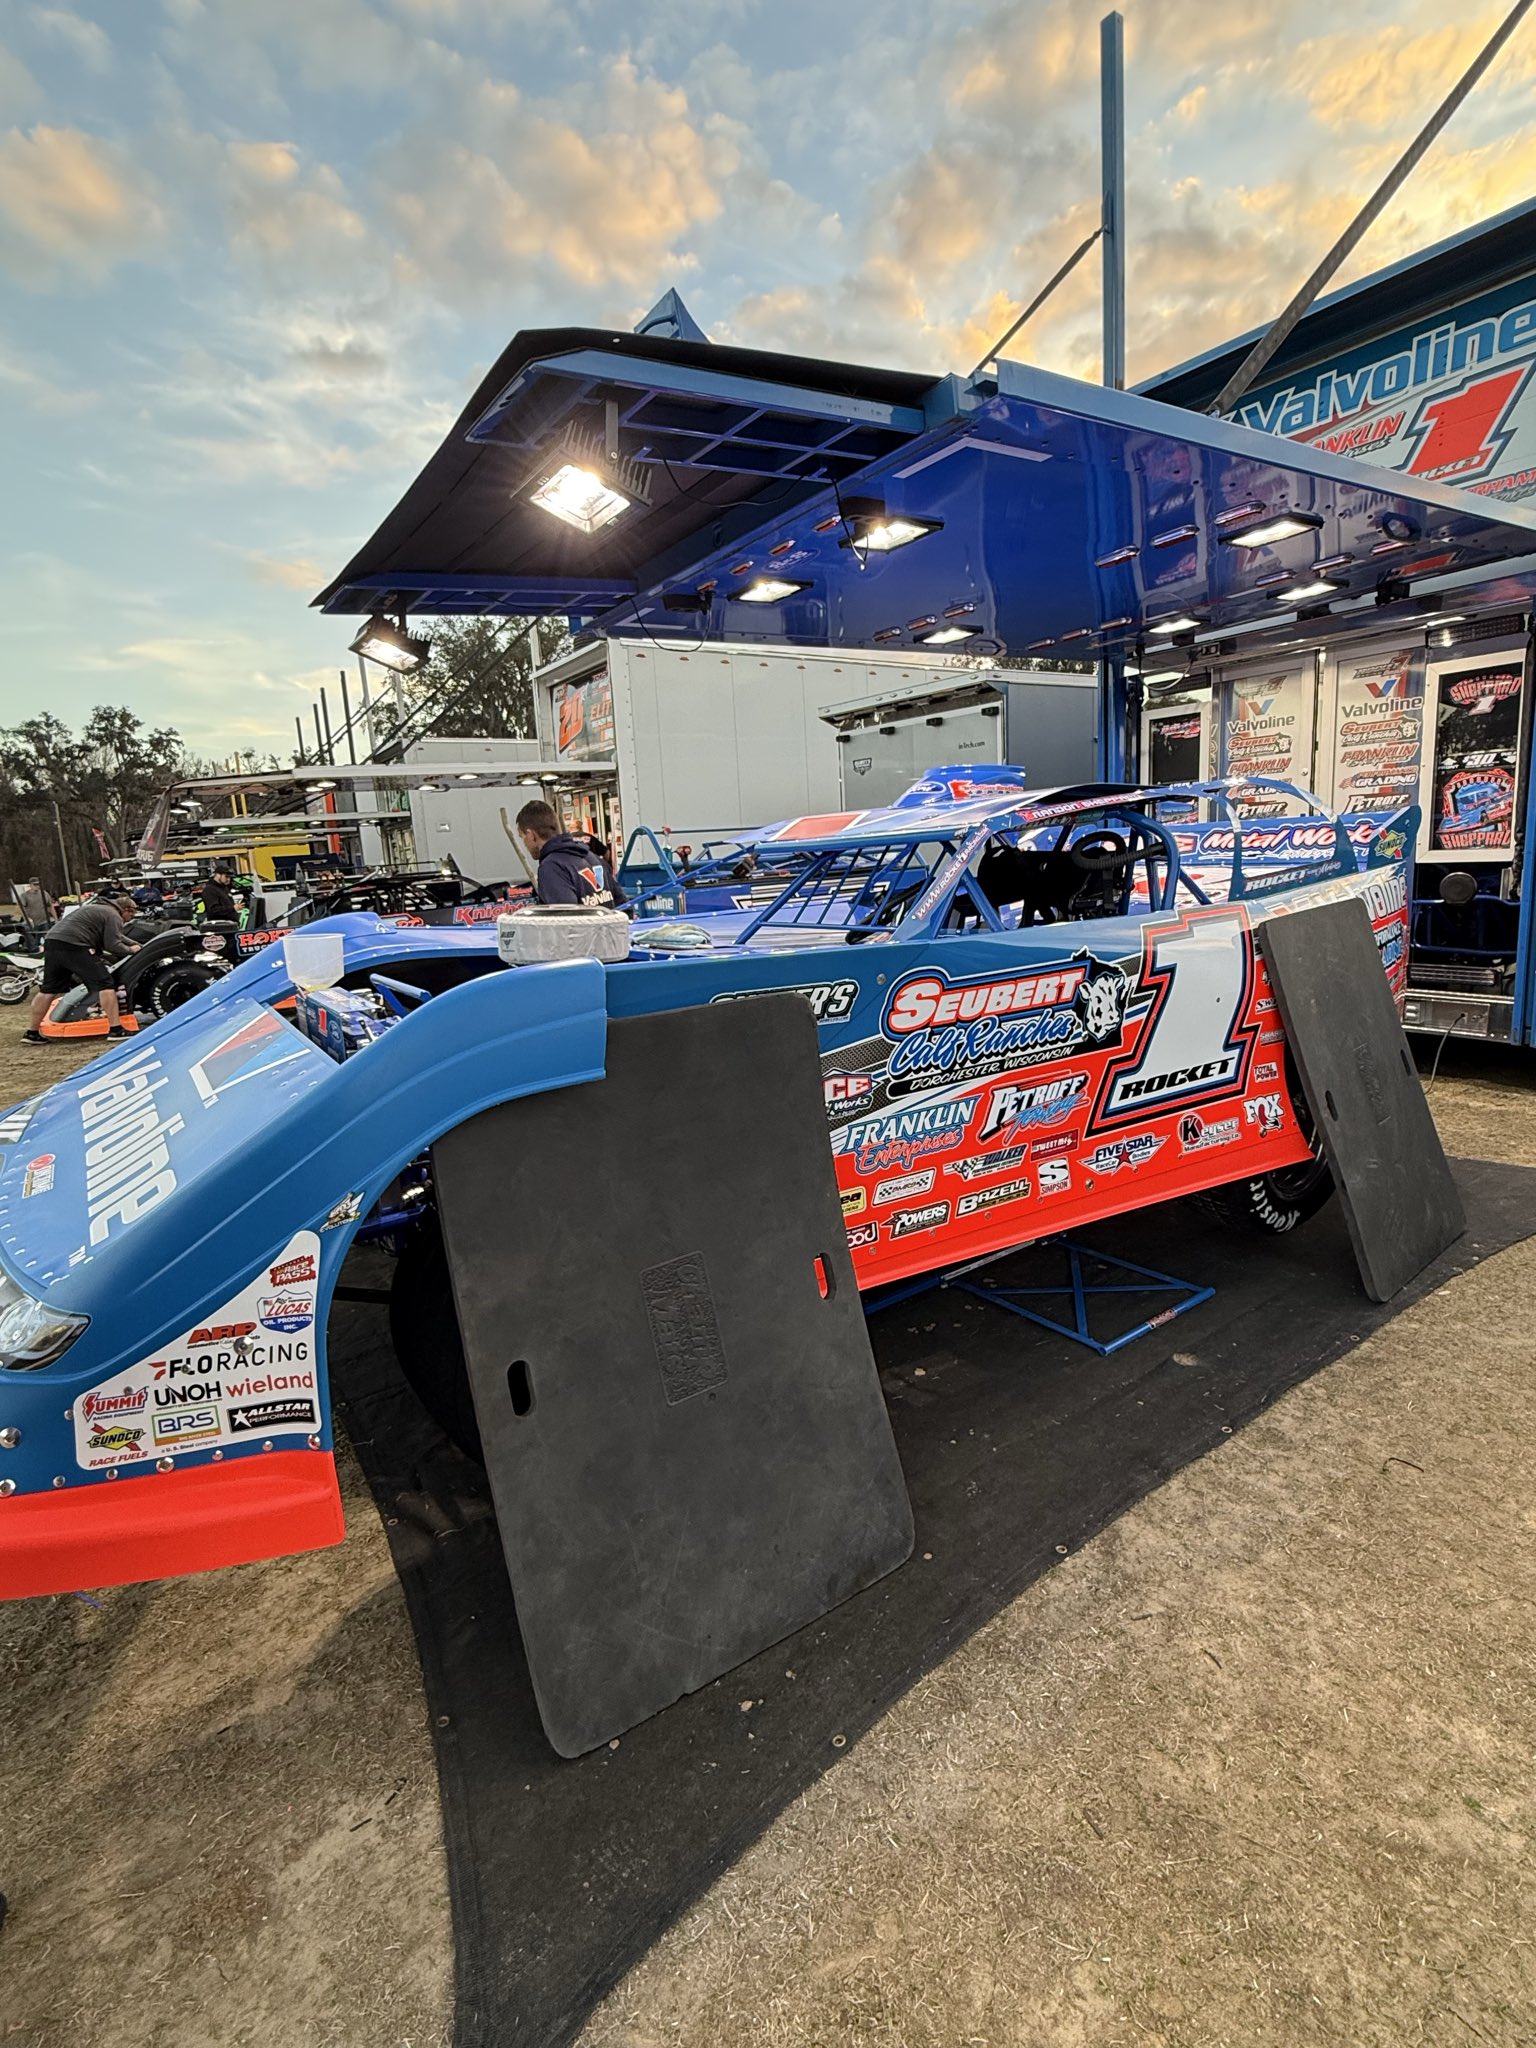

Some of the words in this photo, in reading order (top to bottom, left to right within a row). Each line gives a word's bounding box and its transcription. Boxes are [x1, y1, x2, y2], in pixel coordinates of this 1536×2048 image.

[1403, 360, 1531, 478] 1
[1342, 697, 1424, 718] Valvoline
[1228, 714, 1296, 735] Valvoline
[1355, 774, 1417, 787] GRADING
[1348, 794, 1409, 813] PETROFF
[1204, 829, 1290, 849] Mtal
[1244, 869, 1308, 892] ROCKET
[889, 968, 1085, 1032] SEUBERT
[1097, 912, 1250, 1126] 1
[1004, 1046, 1075, 1070] WISCONSIN
[1254, 1063, 1276, 1075] TOTAL
[1119, 1057, 1236, 1101] ROCKET
[1256, 1071, 1278, 1081] POWER
[834, 1096, 869, 1110] Works
[980, 1075, 1086, 1138] PETROFF
[1243, 1093, 1284, 1127] FOX
[848, 1099, 977, 1149] FRANKLIN
[1183, 1116, 1238, 1142] Keyser
[77, 1045, 177, 1247] Valvoline
[859, 1127, 963, 1170] Enterprises
[983, 1145, 1027, 1165] WALKER
[1096, 1143, 1123, 1160] FIVE
[1125, 1135, 1153, 1151] STAR
[958, 1179, 1029, 1215] BAZELL
[1040, 1180, 1068, 1194] SIMPSON
[895, 1204, 947, 1235] POWERS
[276, 1267, 310, 1284] PASS
[267, 1302, 311, 1317] LUCAS
[277, 1315, 312, 1325] PRODUCTS
[187, 1322, 257, 1344] ARP
[154, 1381, 222, 1406] UNOH
[226, 1371, 313, 1397] wieland
[247, 1402, 311, 1417] ALLSTAR
[249, 1411, 312, 1423] PERFORMANCE
[158, 1411, 214, 1434] BRS
[93, 1430, 141, 1446] SUNOCO
[89, 1456, 118, 1467] RACE
[118, 1451, 149, 1462] FUELS
